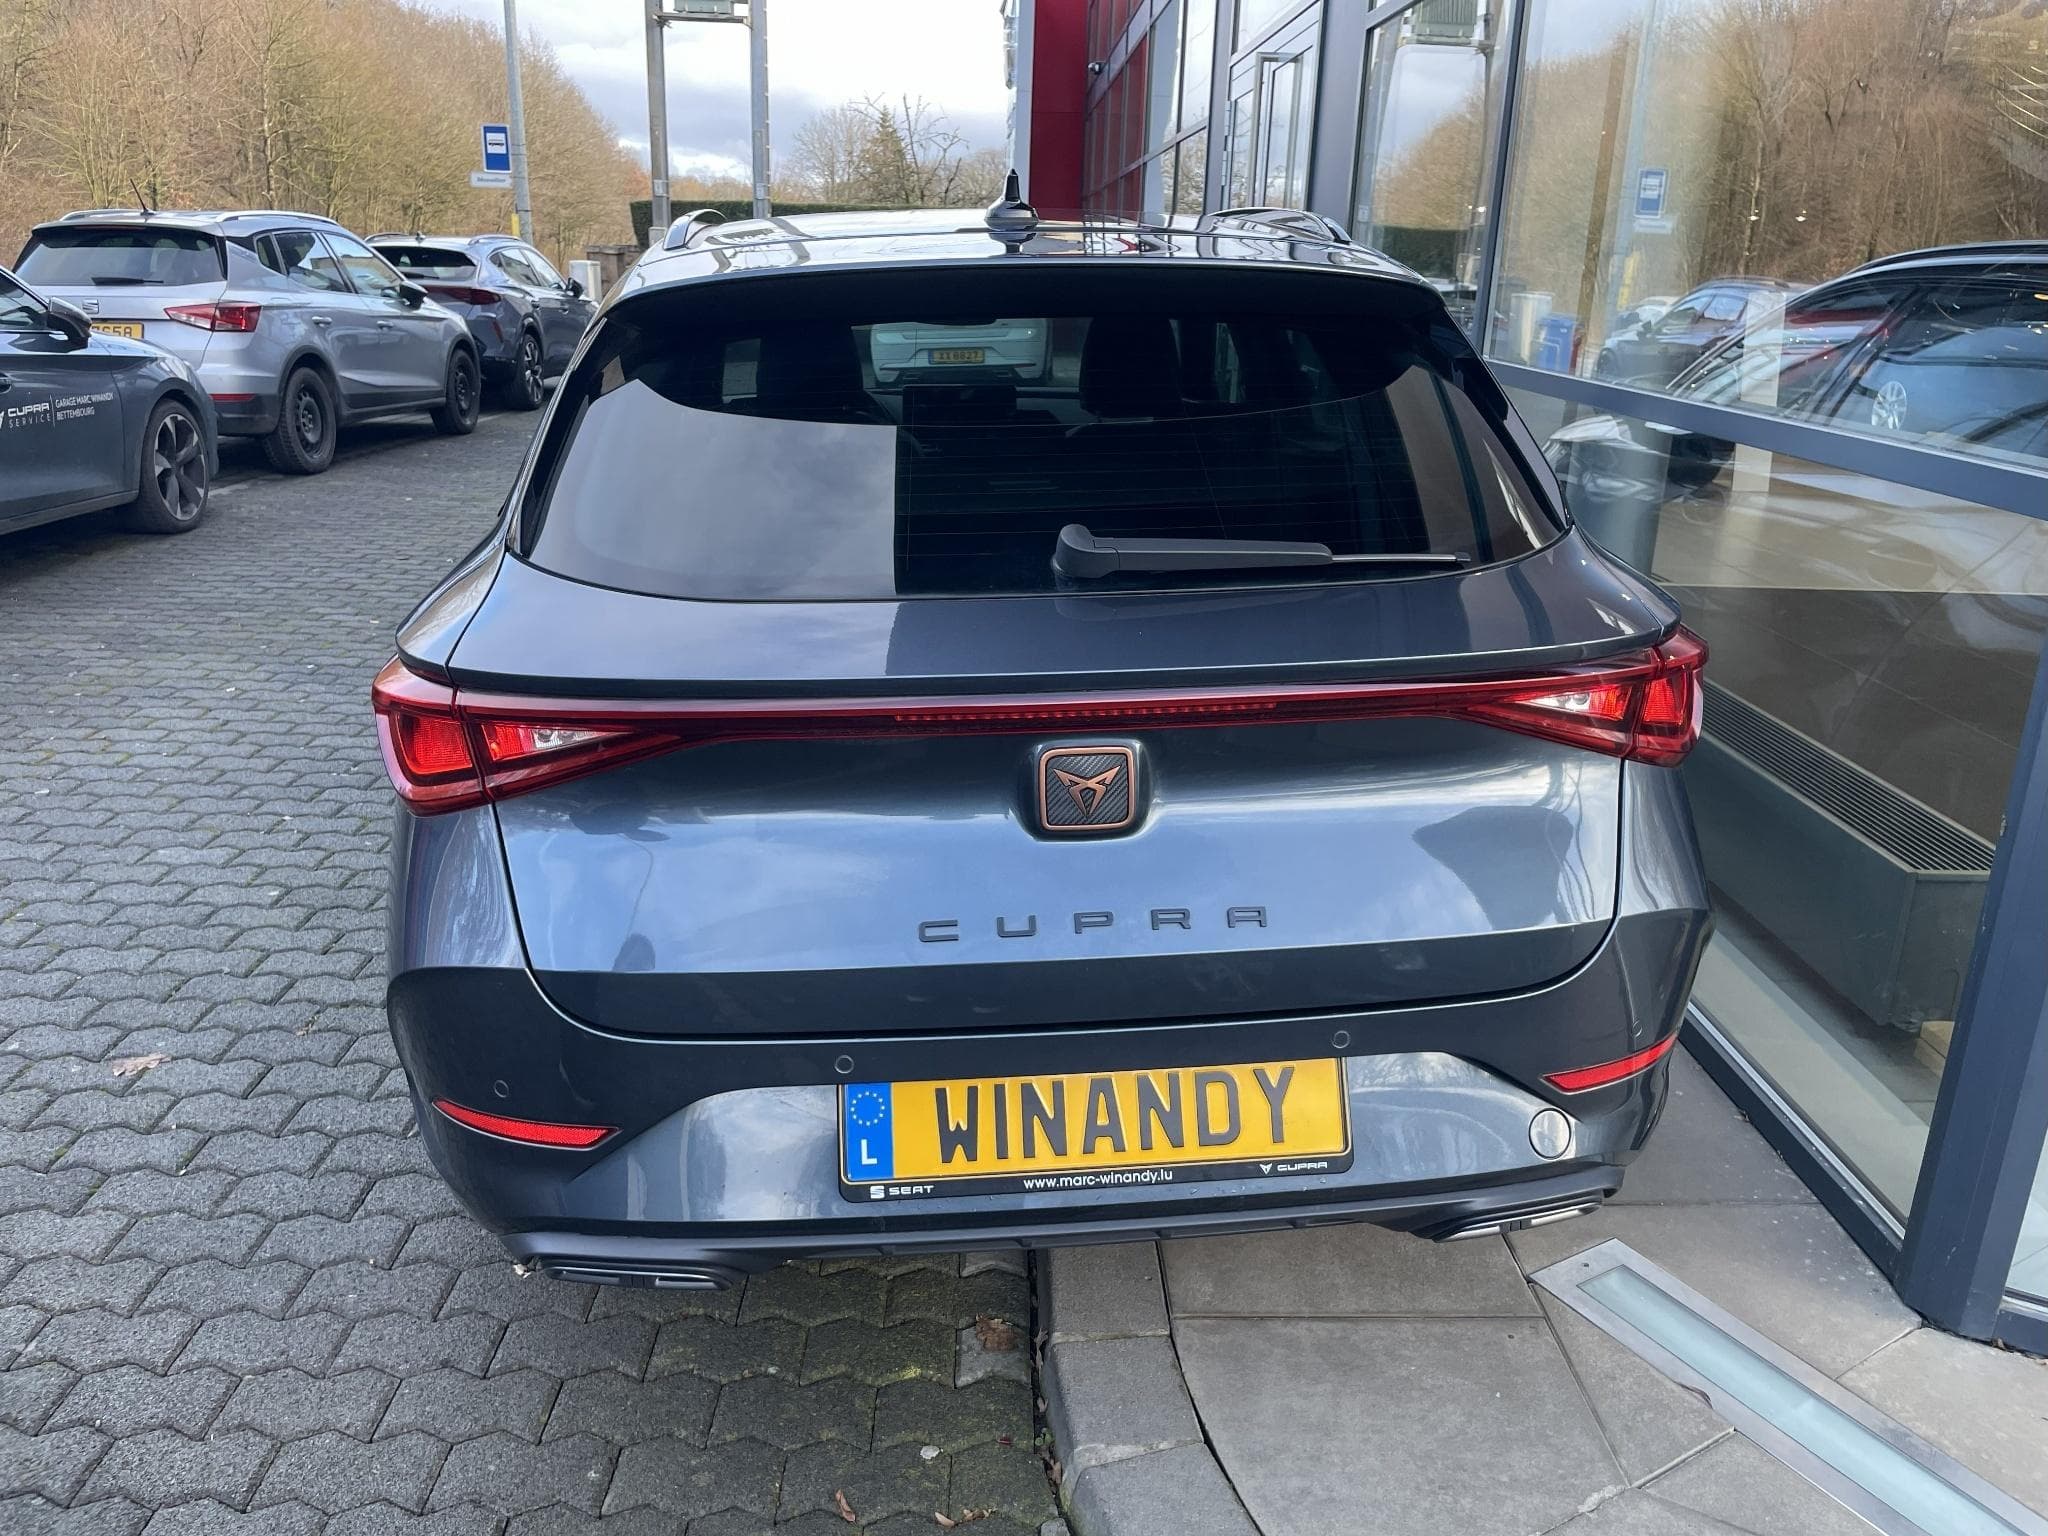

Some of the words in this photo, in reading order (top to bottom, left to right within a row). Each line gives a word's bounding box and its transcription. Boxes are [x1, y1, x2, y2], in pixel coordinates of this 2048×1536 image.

[8, 403, 49, 417] CUPRA
[9, 413, 51, 429] SERVICE
[918, 905, 1268, 943] CUPRA
[861, 1138, 877, 1166] L
[934, 1066, 1296, 1164] WINANDY
[1276, 1161, 1328, 1172] CUPRA
[1023, 1168, 1173, 1190] www.marc-winandy.lu
[888, 1184, 935, 1196] SEAT
